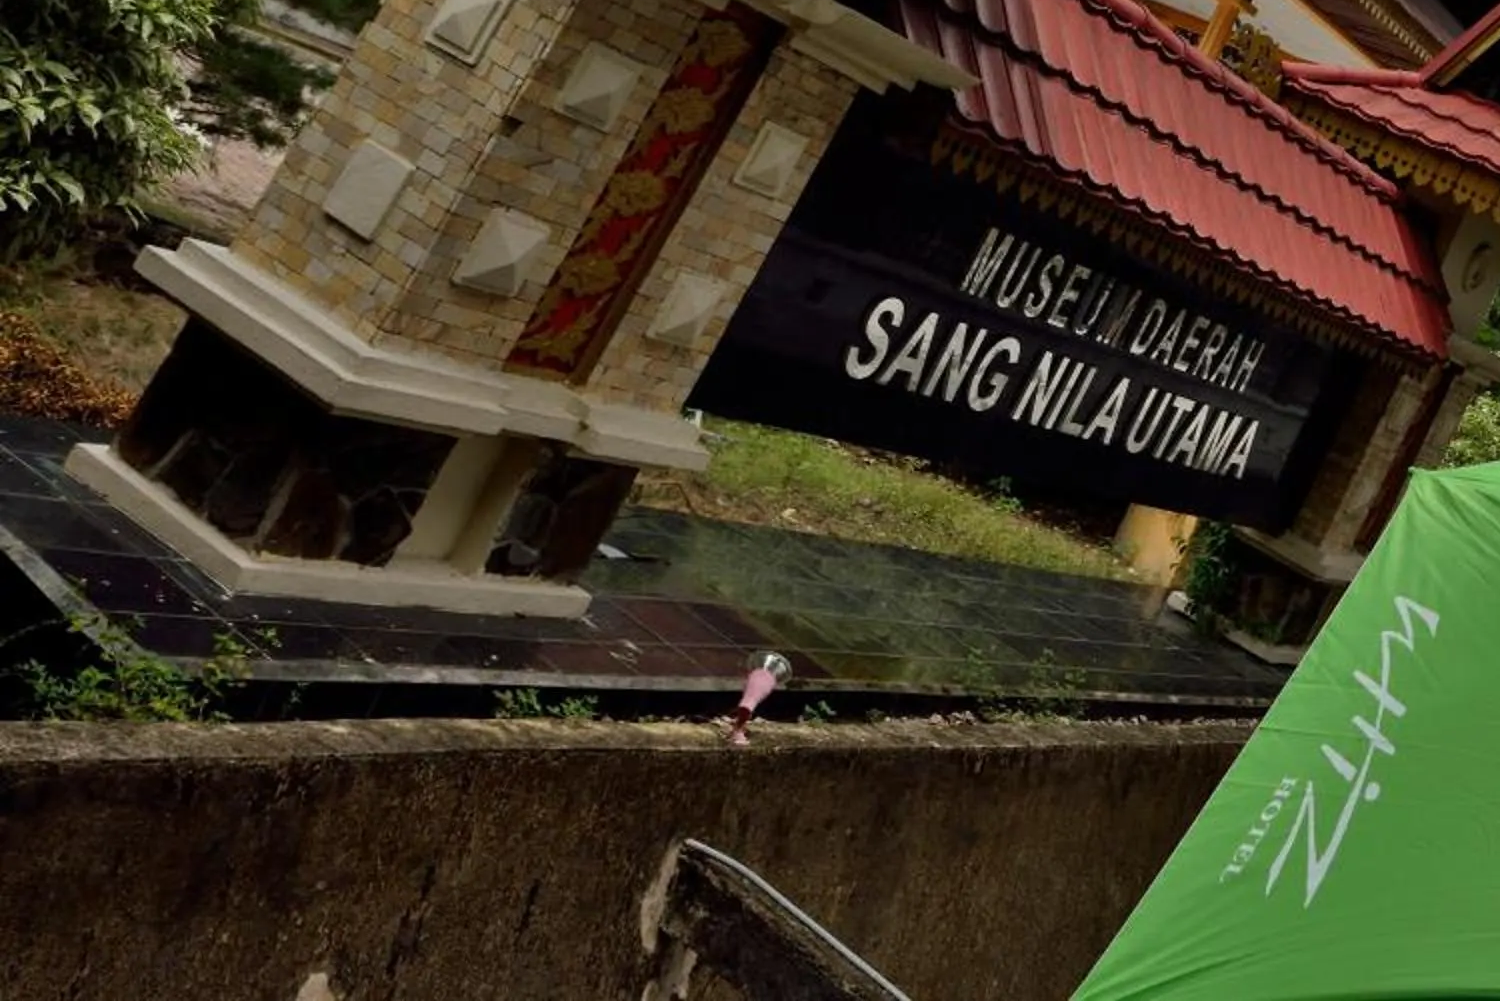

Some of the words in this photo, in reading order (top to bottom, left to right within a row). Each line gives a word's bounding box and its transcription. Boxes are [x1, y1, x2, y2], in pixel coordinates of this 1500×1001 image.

[844, 296, 1021, 413] SANG
[1011, 350, 1131, 446] NILA
[1125, 387, 1260, 480] UTAMA
[1130, 299, 1266, 391] DAERAH
